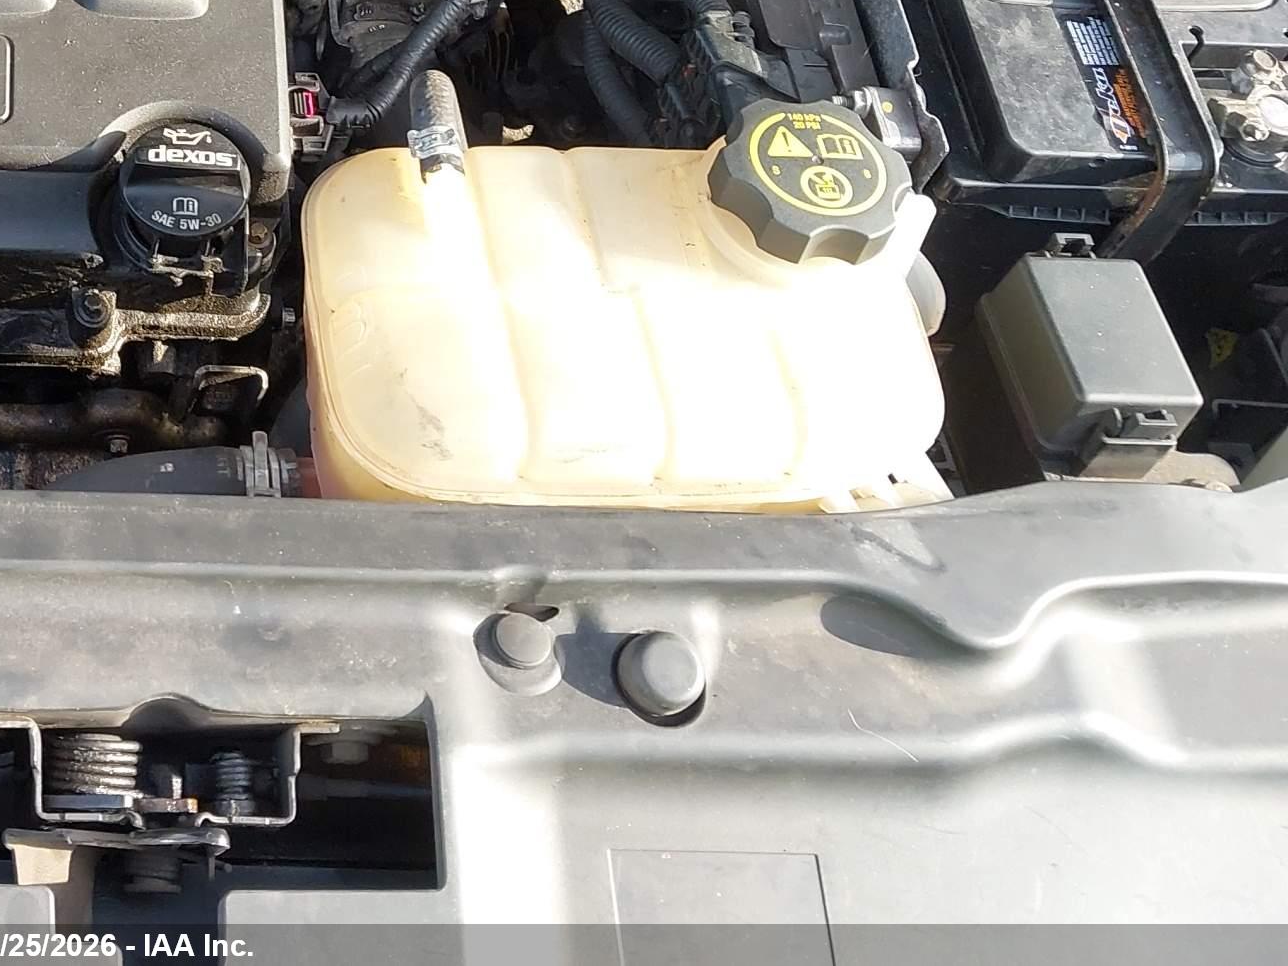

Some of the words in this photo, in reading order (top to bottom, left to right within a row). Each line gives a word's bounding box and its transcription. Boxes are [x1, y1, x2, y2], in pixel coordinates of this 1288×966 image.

[148, 145, 236, 167] dexos
[152, 210, 175, 227] SAE
[179, 213, 222, 230] 5W-30
